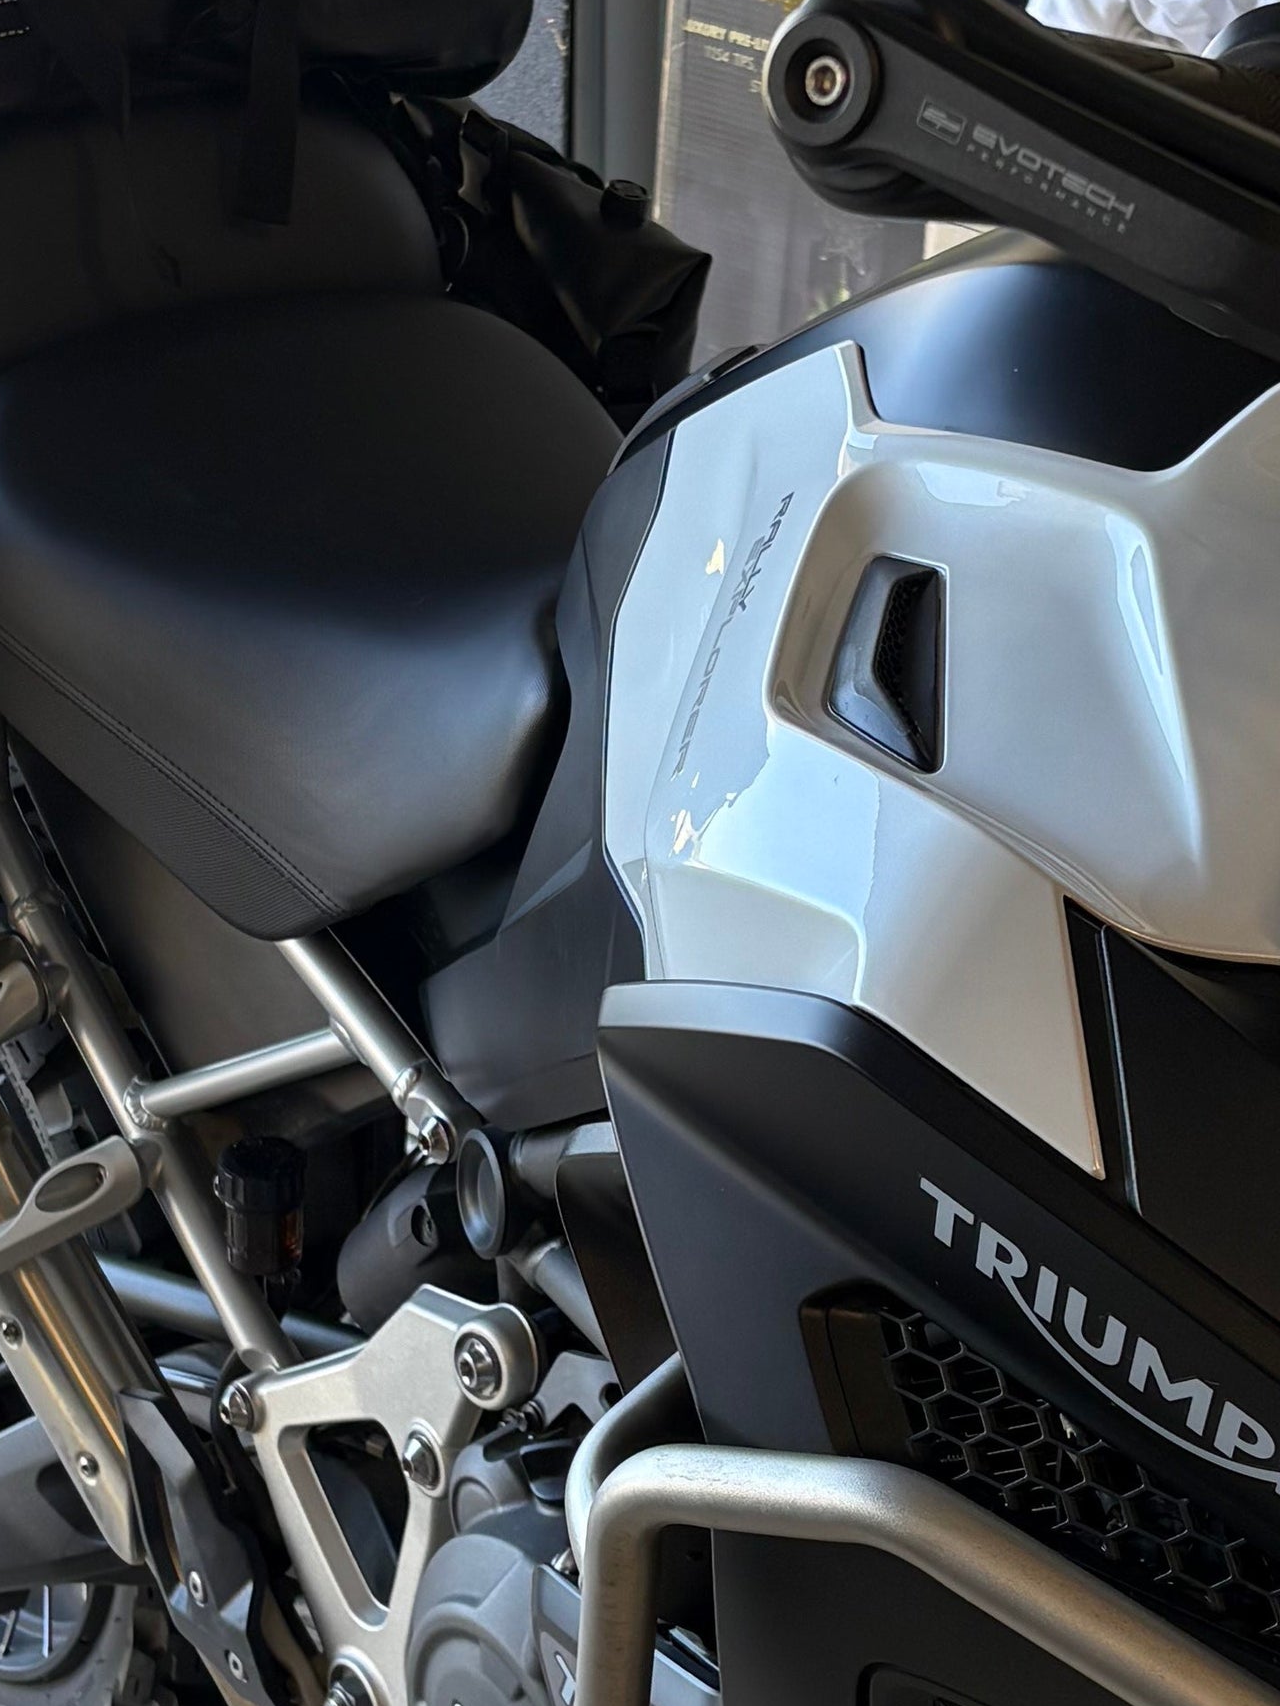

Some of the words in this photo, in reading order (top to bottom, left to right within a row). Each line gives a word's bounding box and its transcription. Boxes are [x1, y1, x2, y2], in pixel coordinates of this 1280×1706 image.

[965, 142, 1128, 236] PERFORMANCE
[971, 122, 1137, 222] EVOTECH
[738, 491, 795, 612] RALLY
[670, 534, 766, 782] EXPLORER
